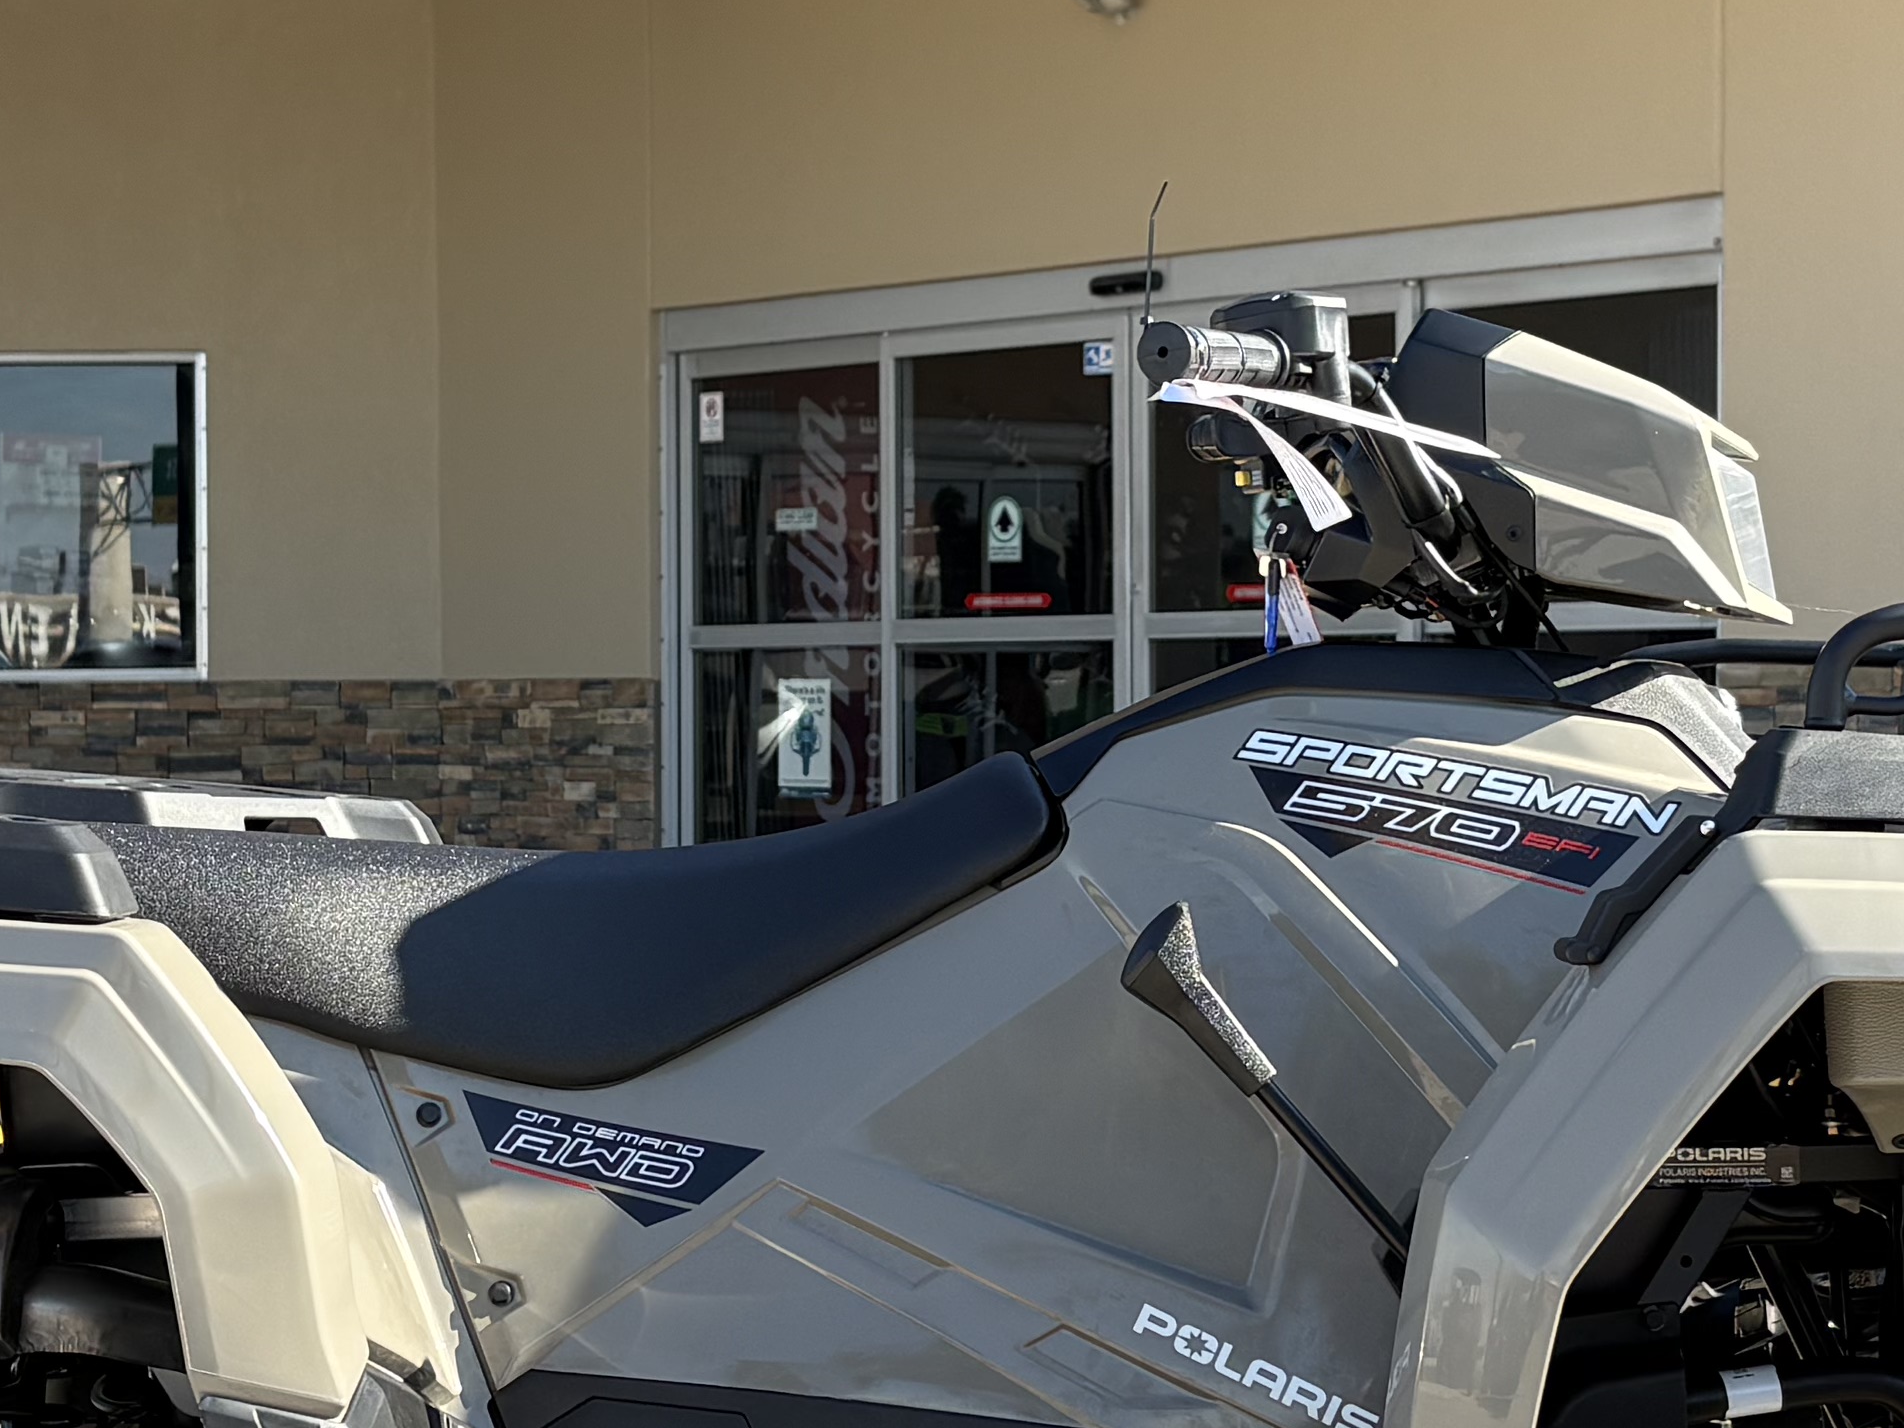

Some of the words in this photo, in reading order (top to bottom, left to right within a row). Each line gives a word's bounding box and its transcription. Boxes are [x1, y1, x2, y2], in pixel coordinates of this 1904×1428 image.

[1234, 729, 1679, 834] SPORTSMAN
[1283, 781, 1522, 853] 570
[1523, 829, 1600, 861] EFI
[494, 1125, 695, 1190] AWD
[515, 1108, 561, 1128] ON
[572, 1122, 705, 1158] DEMAND
